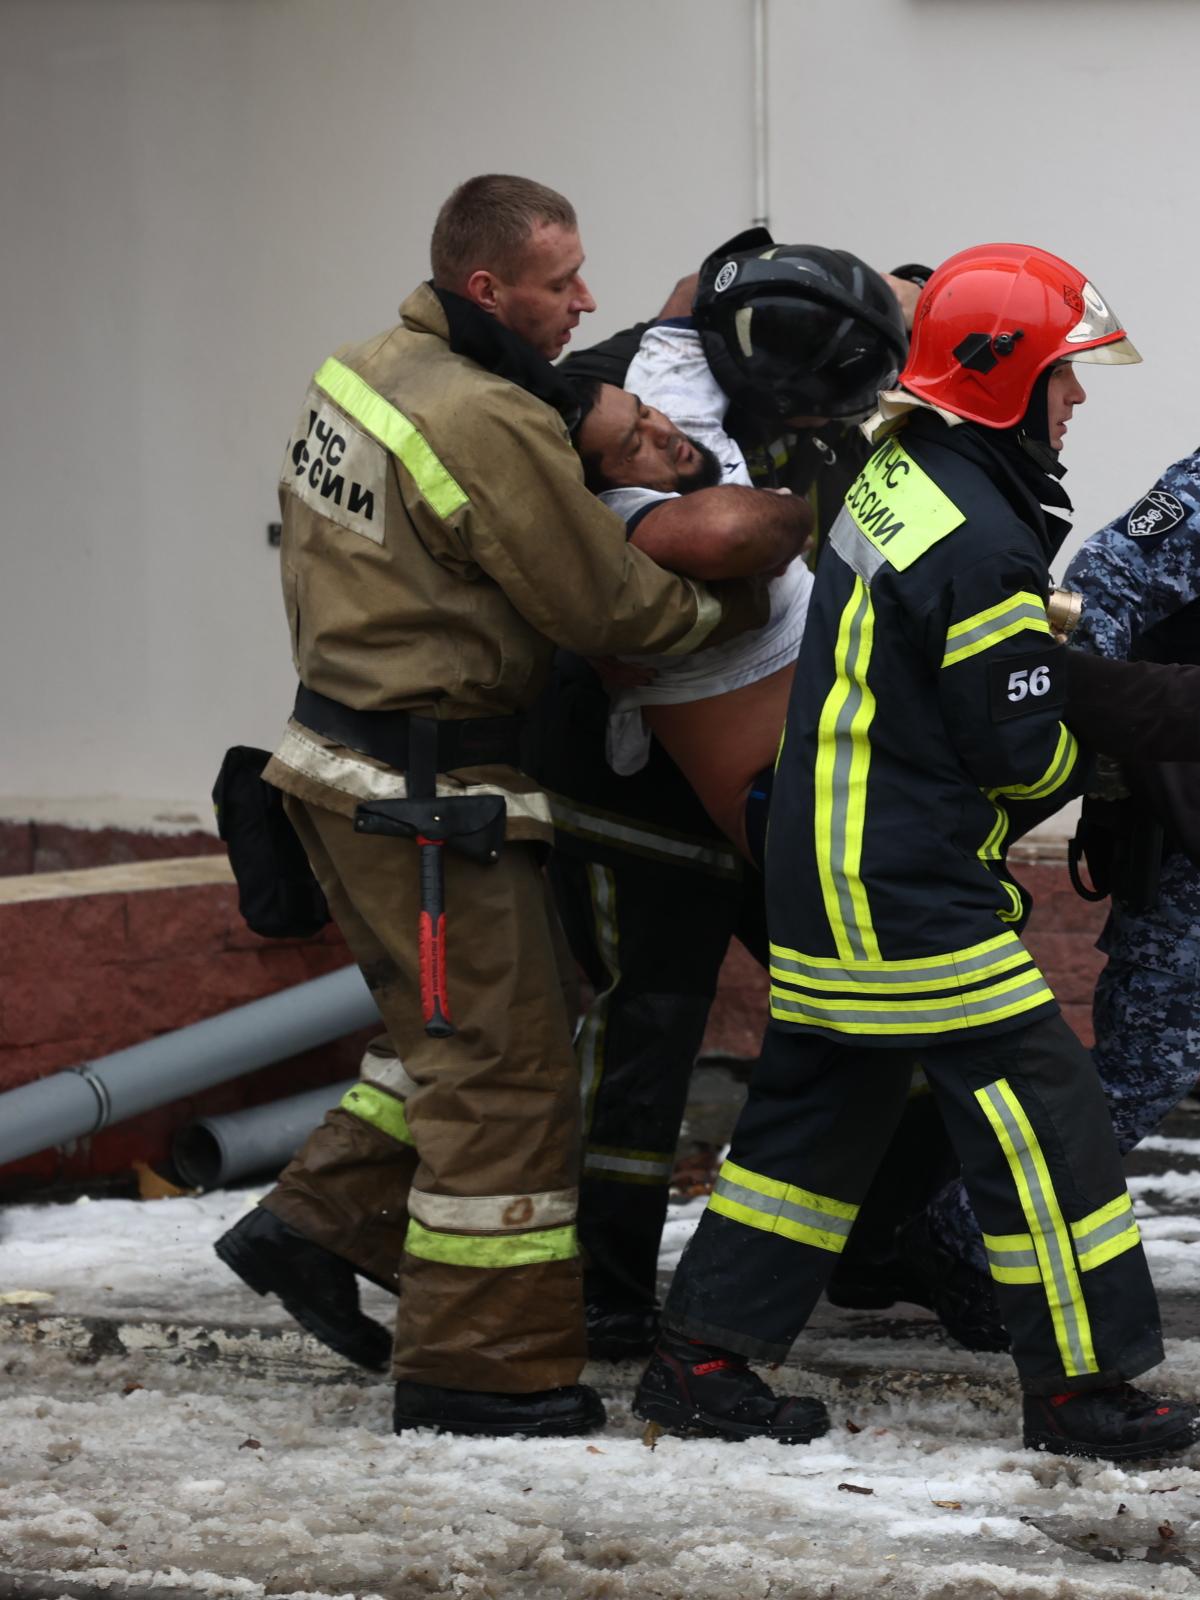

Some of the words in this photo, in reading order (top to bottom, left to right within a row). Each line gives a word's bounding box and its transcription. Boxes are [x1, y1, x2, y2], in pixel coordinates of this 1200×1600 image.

[287, 438, 375, 521] ССИИ
[847, 472, 906, 547] ОССИИ
[1007, 665, 1051, 702] 56
